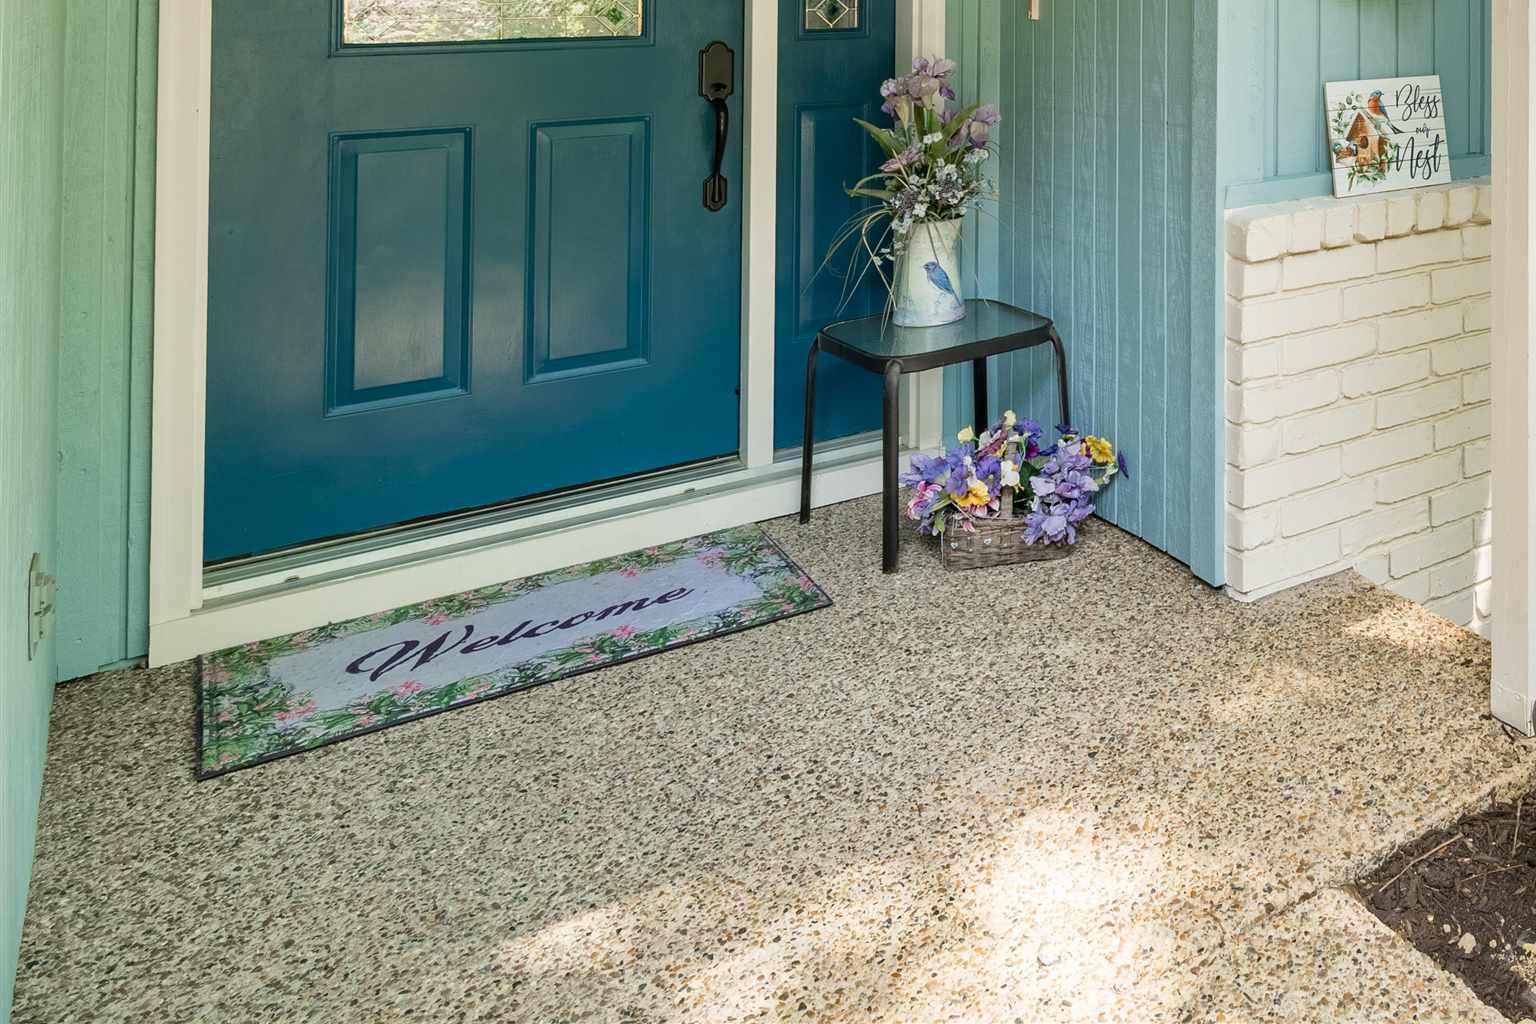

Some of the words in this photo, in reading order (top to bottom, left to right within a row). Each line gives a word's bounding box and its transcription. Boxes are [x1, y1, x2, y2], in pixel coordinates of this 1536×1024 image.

[1395, 83, 1441, 122] Bless
[1396, 134, 1445, 181] Nest
[345, 582, 697, 683] Welcome
